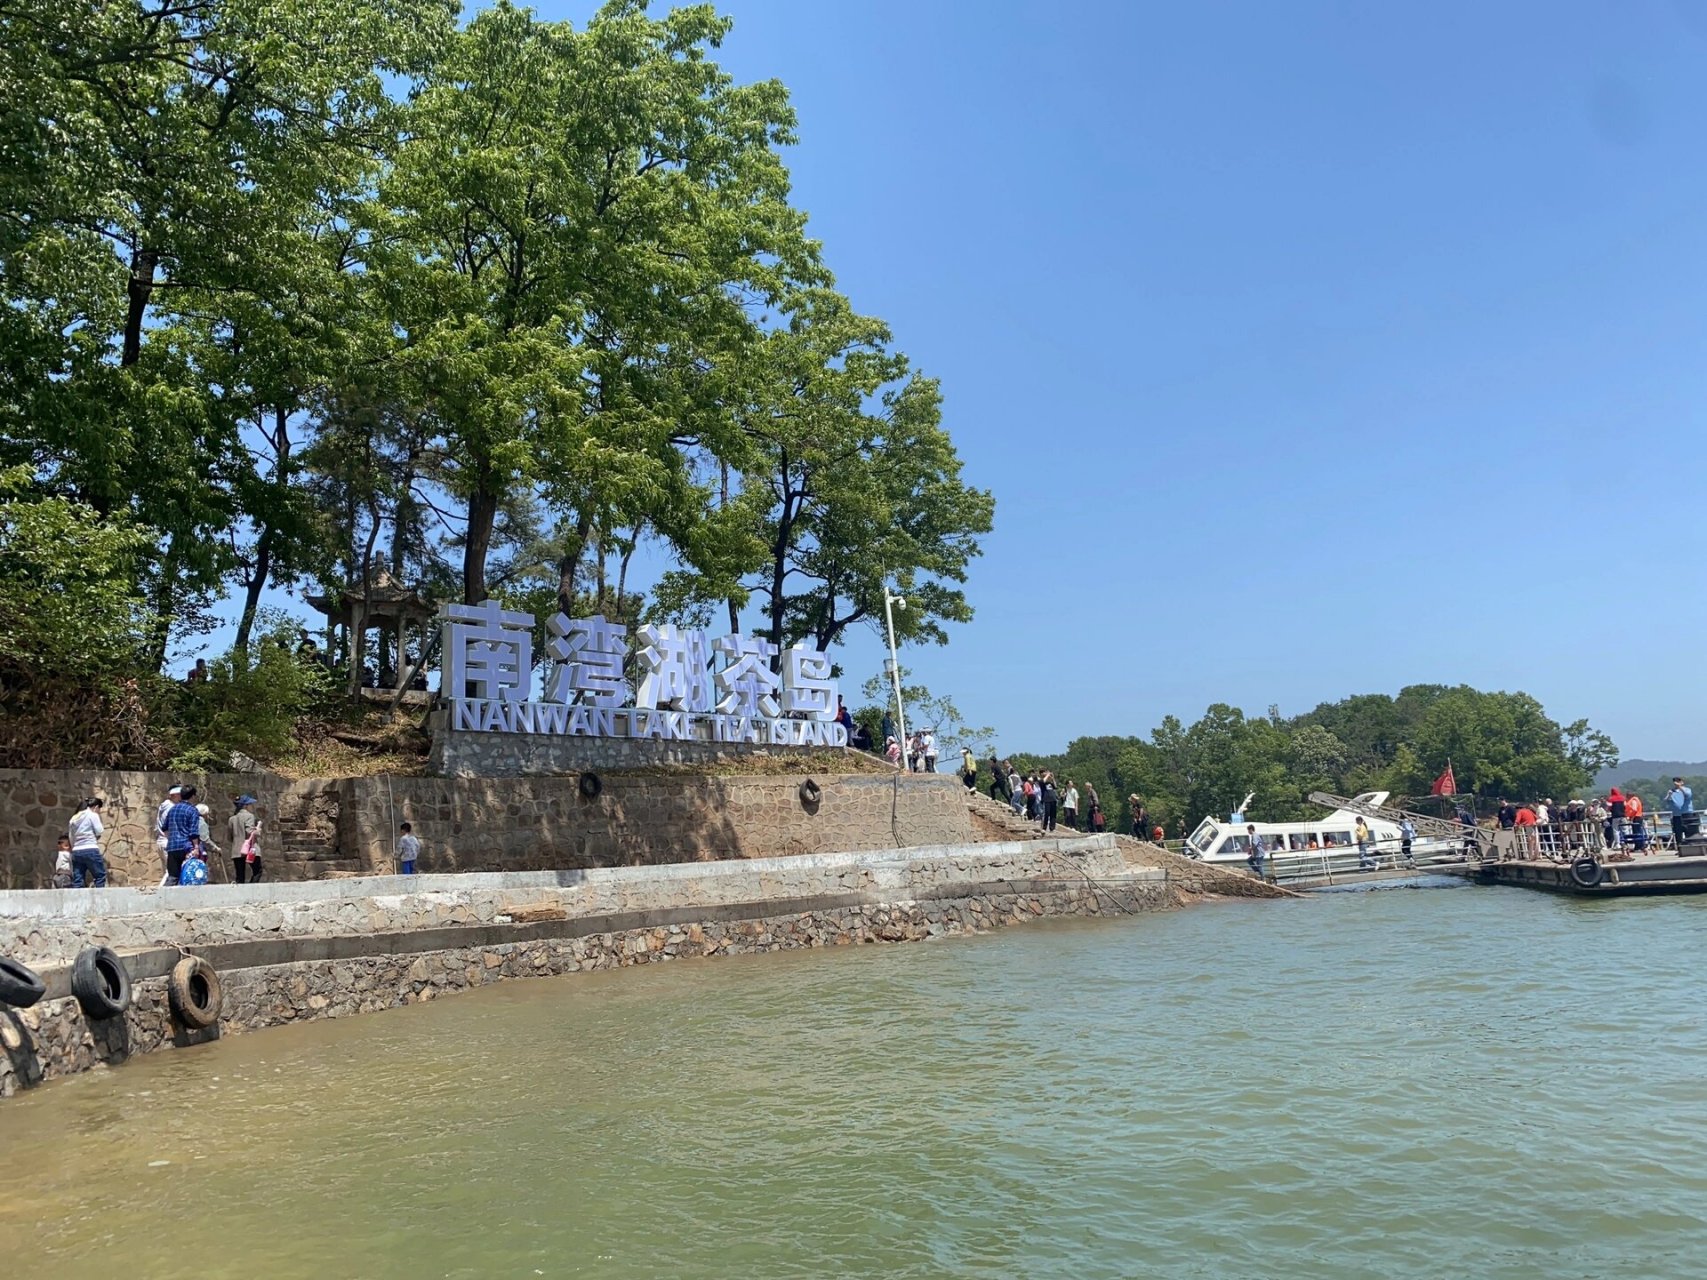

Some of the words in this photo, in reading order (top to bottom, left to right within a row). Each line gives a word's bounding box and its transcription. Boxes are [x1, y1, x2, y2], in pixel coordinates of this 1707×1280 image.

[440, 600, 839, 722] 南湾湖茶岛
[453, 699, 615, 738] NANWAN
[627, 709, 697, 741] LAKE
[710, 714, 756, 743] TEA
[769, 719, 848, 747] ISLAND
